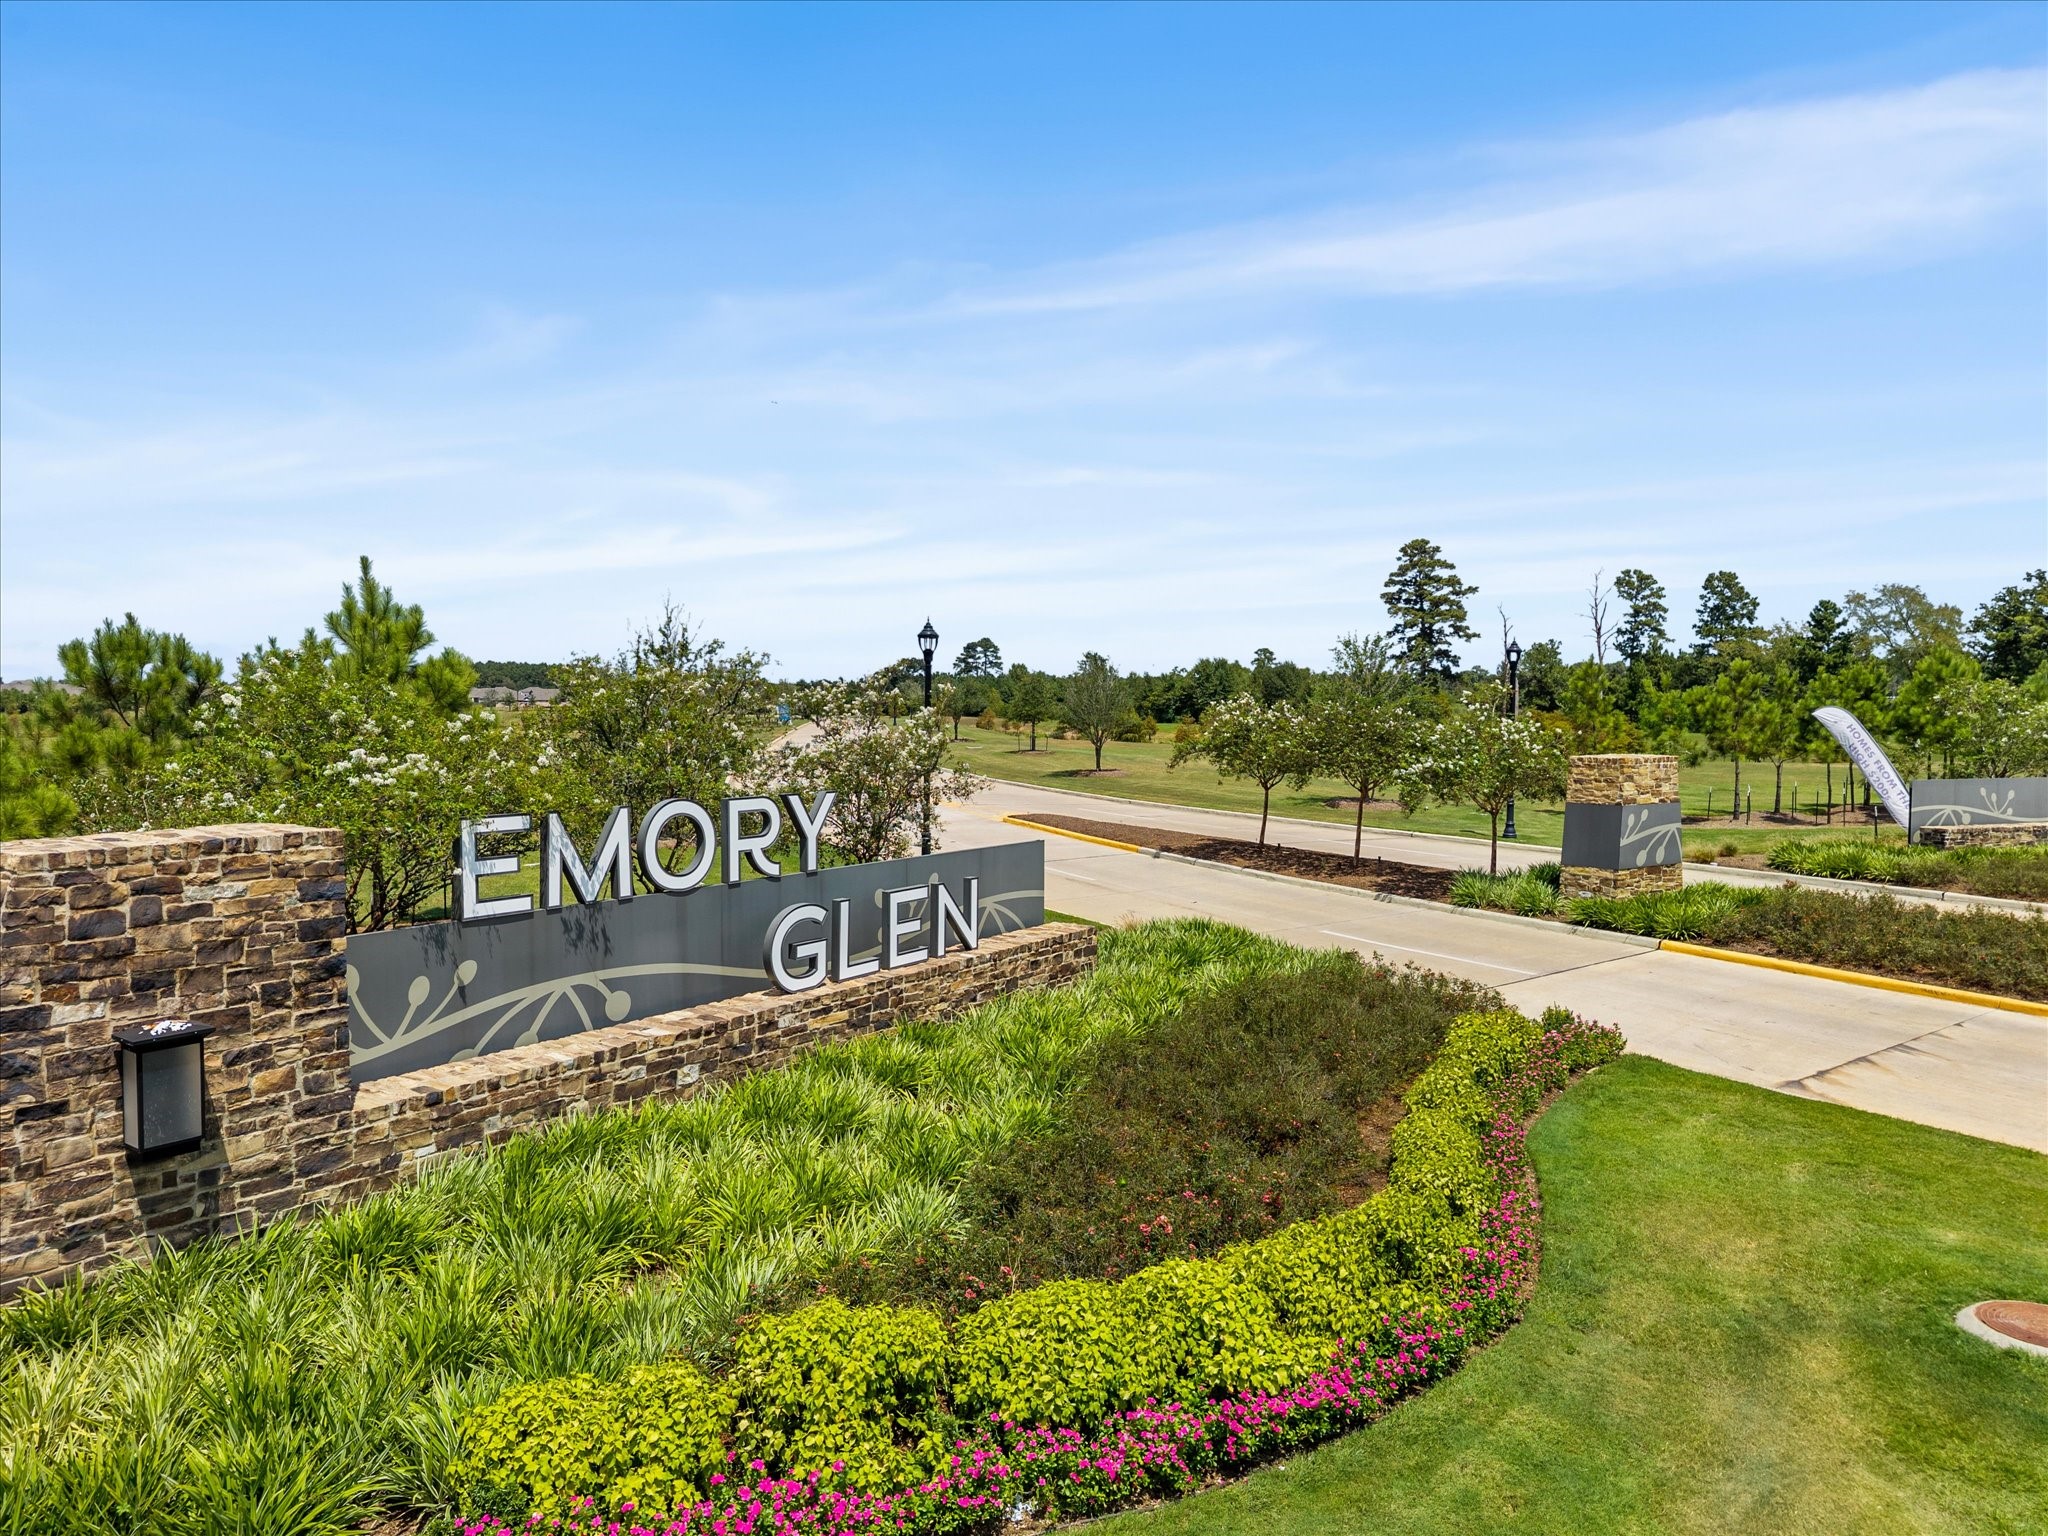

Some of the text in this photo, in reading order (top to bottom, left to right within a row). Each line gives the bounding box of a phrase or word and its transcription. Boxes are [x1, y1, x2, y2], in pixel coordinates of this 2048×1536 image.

[1846, 724, 1875, 758] HOMES
[1874, 760, 1897, 789] FROM
[1848, 742, 1870, 769] HIGH
[453, 791, 836, 921] EMORY
[763, 876, 978, 994] GLEN
